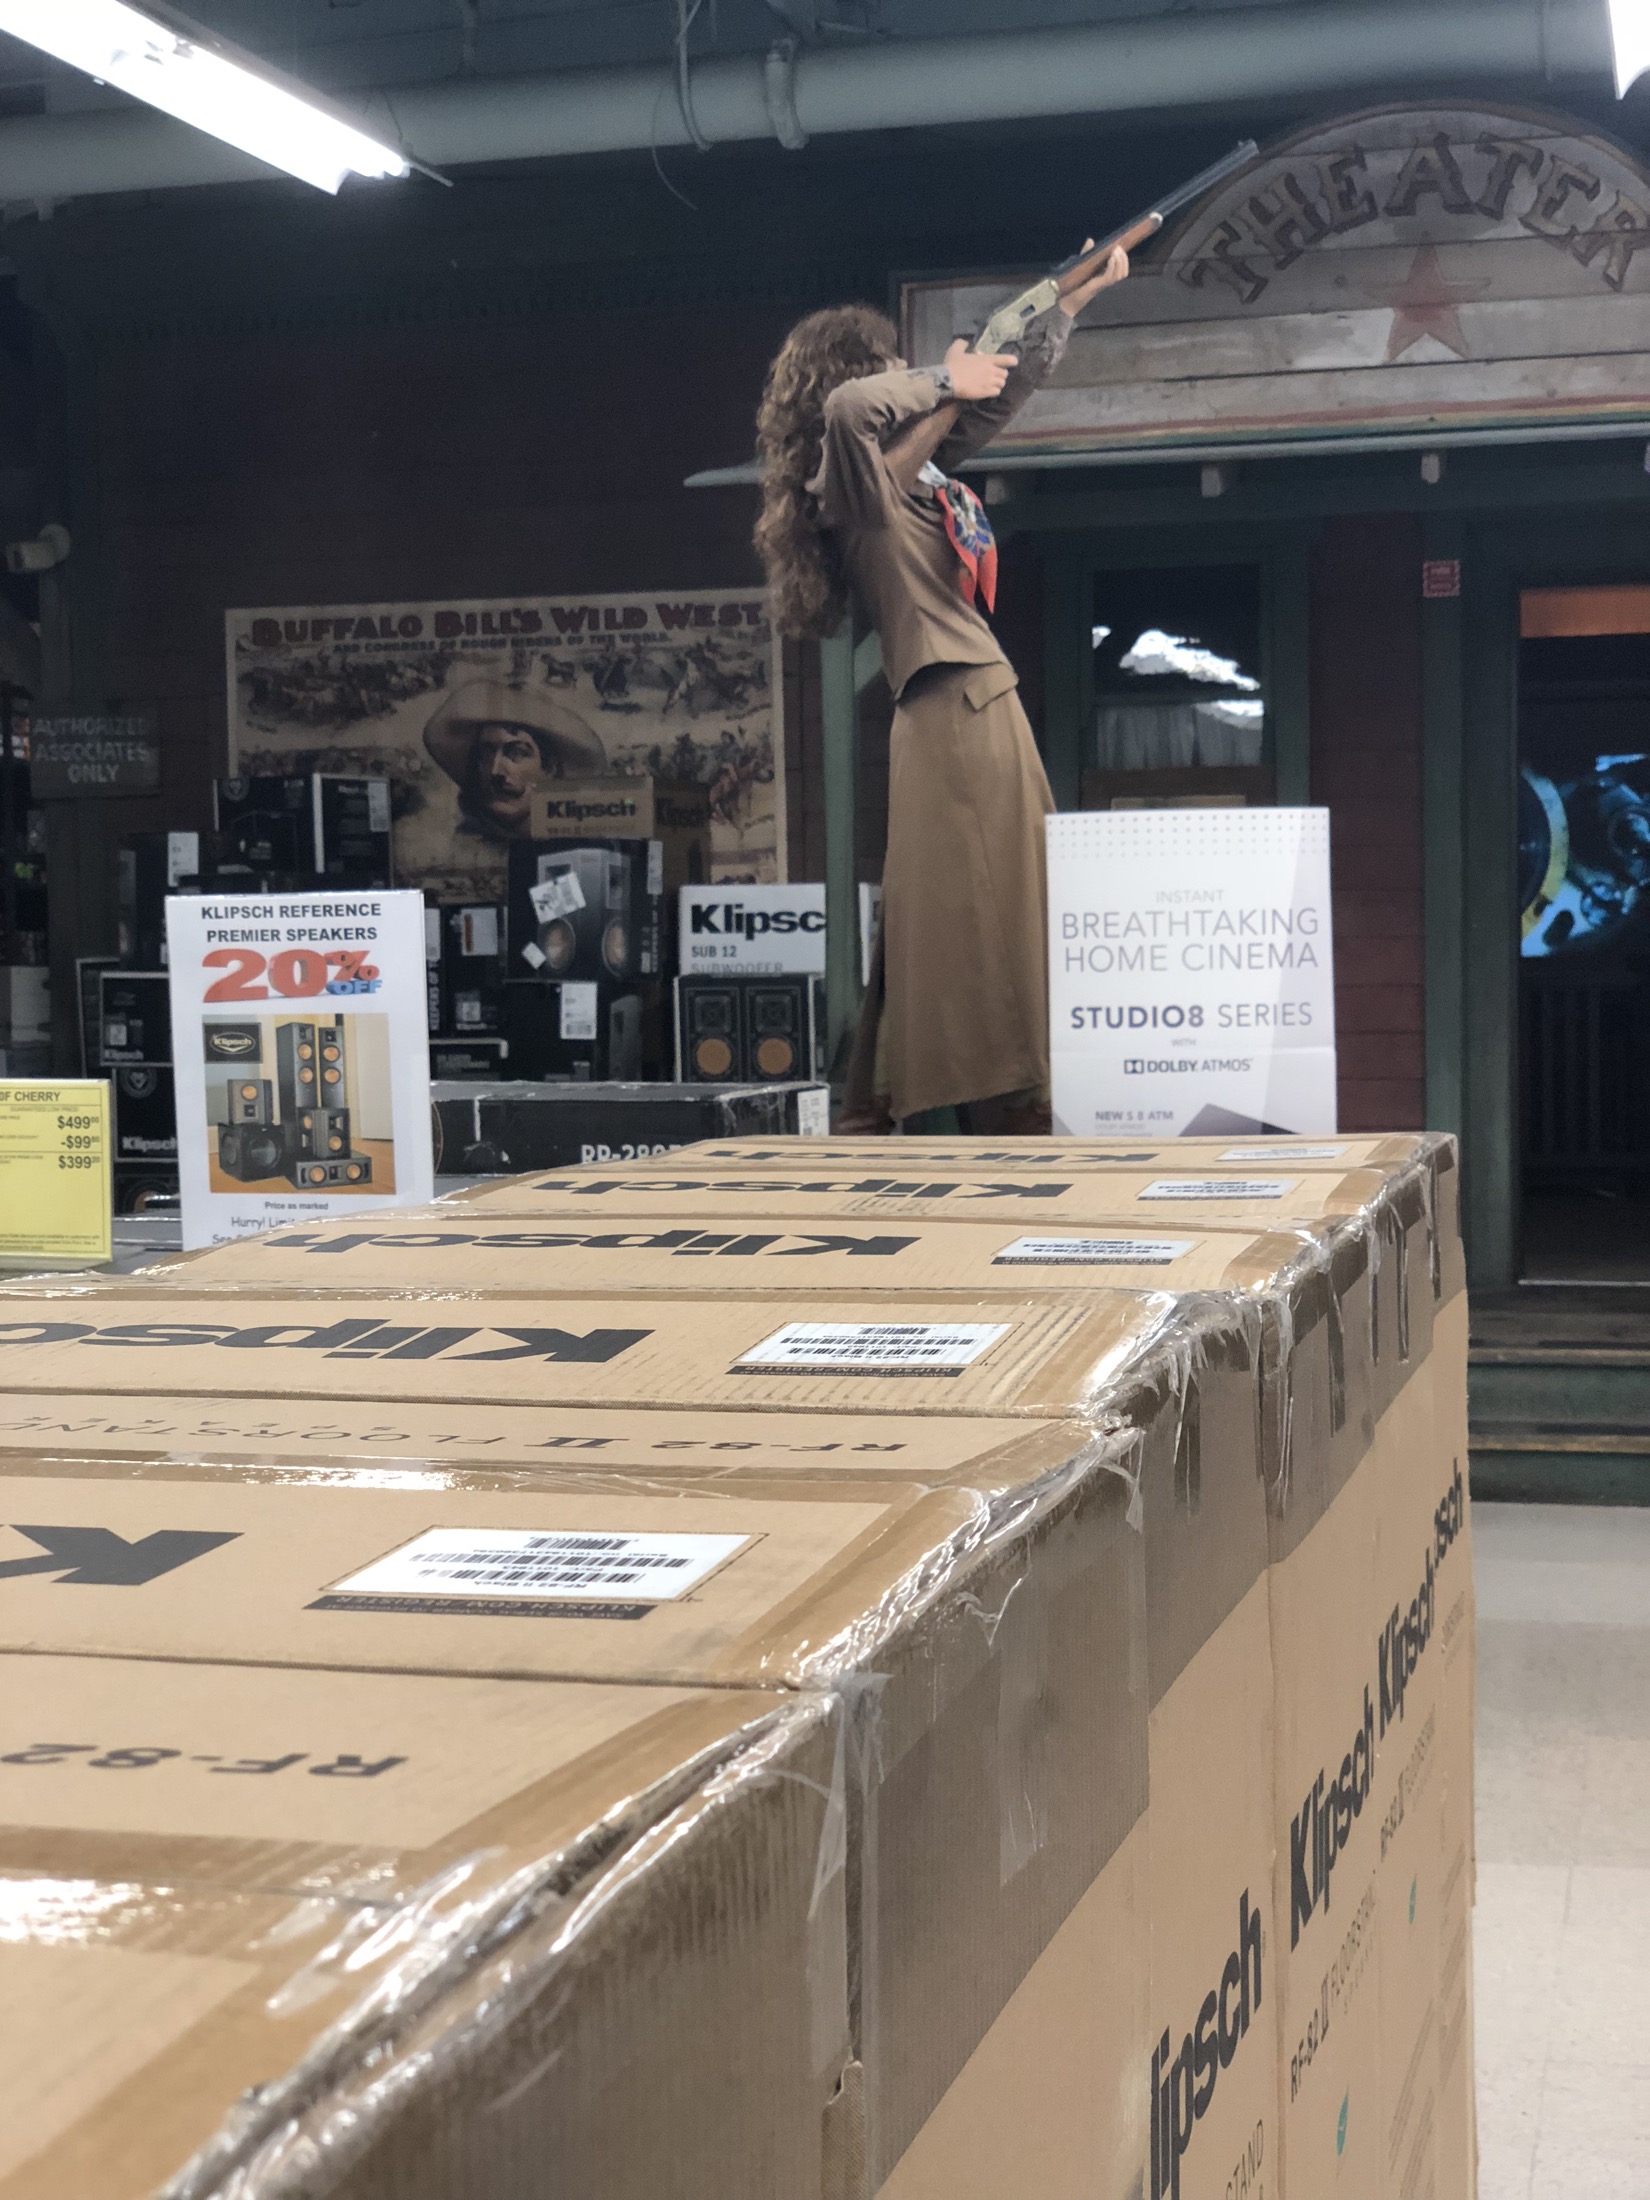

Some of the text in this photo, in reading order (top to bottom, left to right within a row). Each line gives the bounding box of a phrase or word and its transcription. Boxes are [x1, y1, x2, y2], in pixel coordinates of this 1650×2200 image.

[1179, 131, 1650, 304] THEATER
[251, 602, 763, 647] BUFFALO BILL'S WILD WEST
[34, 742, 149, 762] ASSOCIATES
[67, 764, 120, 783] ONLY
[547, 798, 636, 821] Klipsch
[1155, 889, 1225, 903] INSTANT
[201, 901, 382, 920] KLIPSCH REFERENCE
[1062, 908, 1319, 940] BREATHTAKING
[206, 926, 378, 944] PREMIER SPEAKERS
[691, 945, 738, 958] SUB 12
[1064, 942, 1319, 973] HOME CINEMA
[202, 949, 381, 1003] 20%
[326, 979, 383, 995] OFF
[1071, 1002, 1313, 1030] STUDIO8 SERIES
[1170, 1038, 1197, 1047] WITH
[1147, 1059, 1199, 1074] DOLBY
[14, 1091, 61, 1101] CHERRY
[1095, 1111, 1123, 1121] NEW
[701, 1152, 1160, 1164] Klipsch
[532, 1179, 1074, 1199] Klipsch
[265, 1201, 287, 1210] Price
[299, 1201, 329, 1210] marked
[231, 1216, 266, 1230] Hurry!
[264, 1230, 922, 1257] Klipsch
[650, 1440, 908, 1452] RF-82
[1378, 1547, 1434, 1744] Klipsch
[0, 1743, 408, 1780] RF-82
[1289, 1684, 1375, 1951] Klipsch
[1290, 2020, 1319, 2105] RF-82
